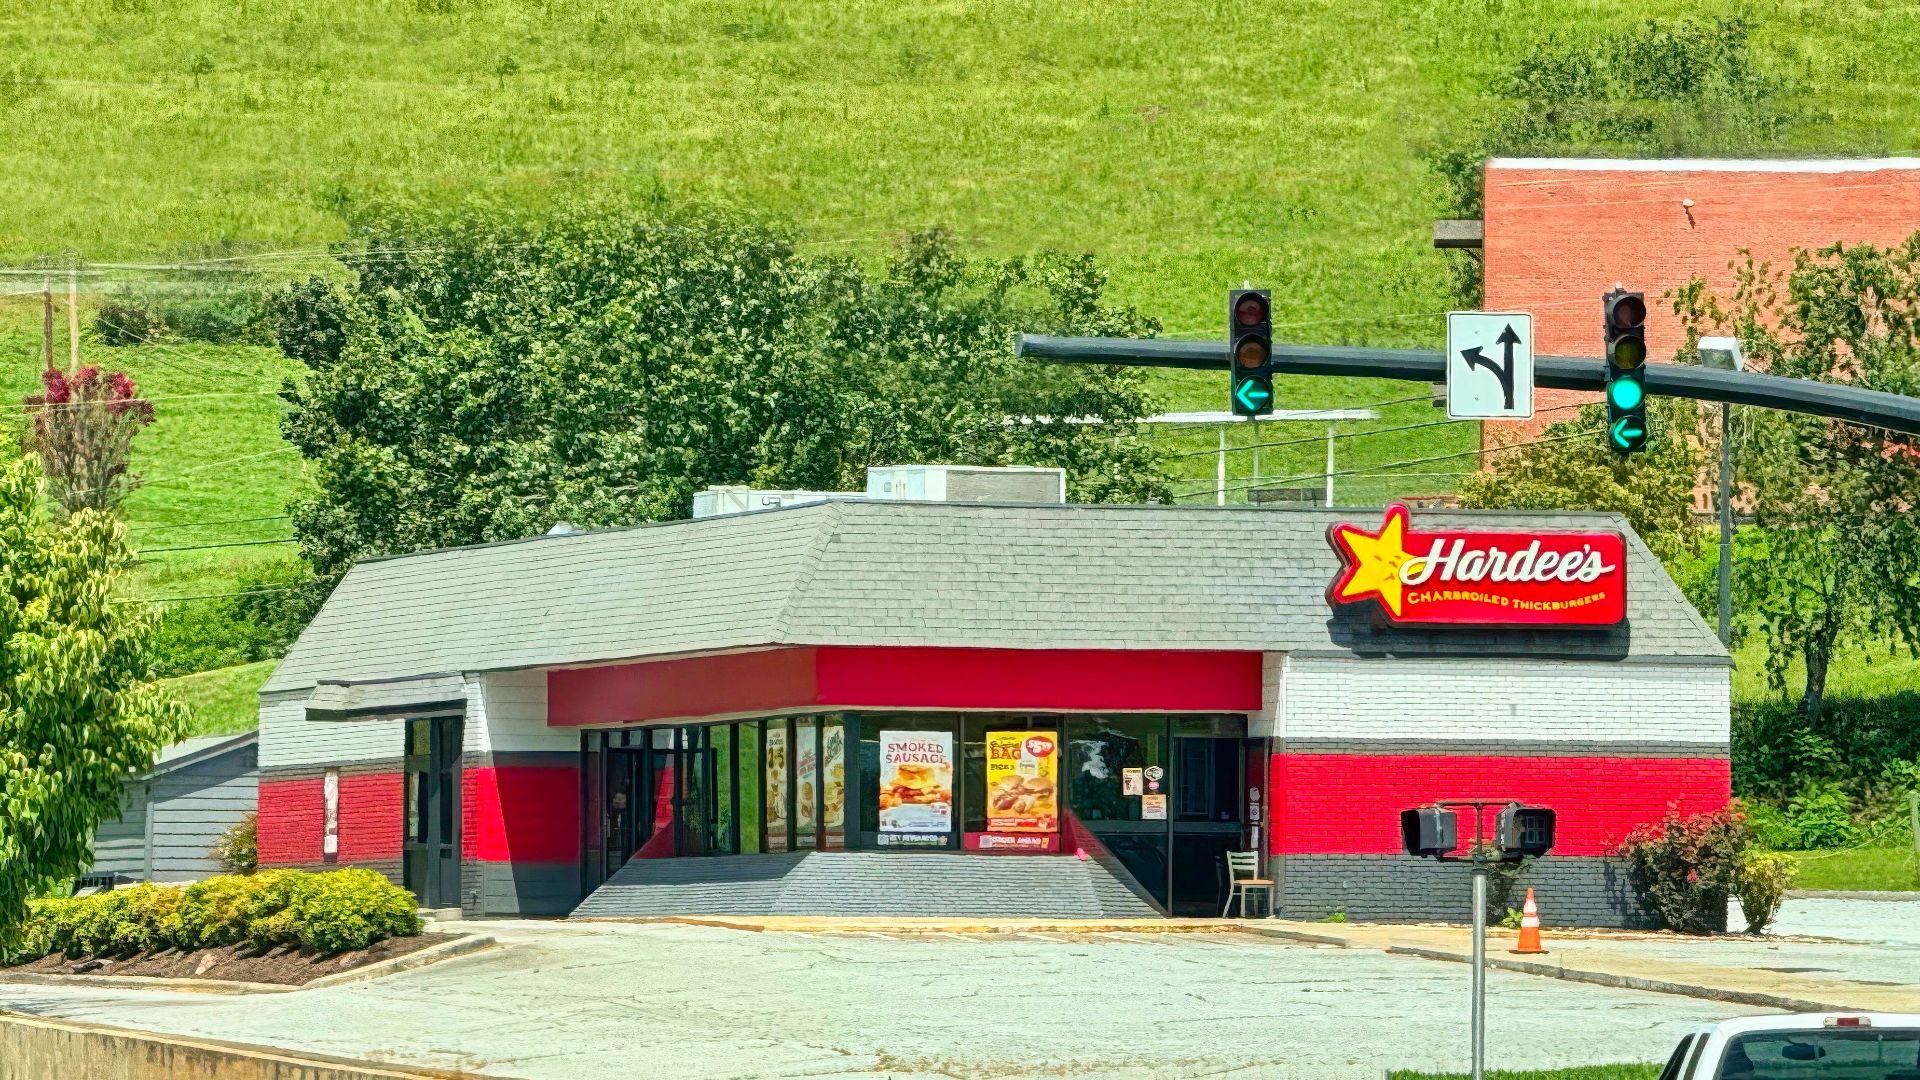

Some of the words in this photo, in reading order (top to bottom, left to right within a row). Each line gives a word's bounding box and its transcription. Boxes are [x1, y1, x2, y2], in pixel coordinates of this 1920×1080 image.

[1399, 538, 1616, 585] Hardee's
[1407, 590, 1509, 607] CHARBROILED
[1513, 591, 1606, 610] THICKBURGERS
[888, 742, 944, 753] SMOKED
